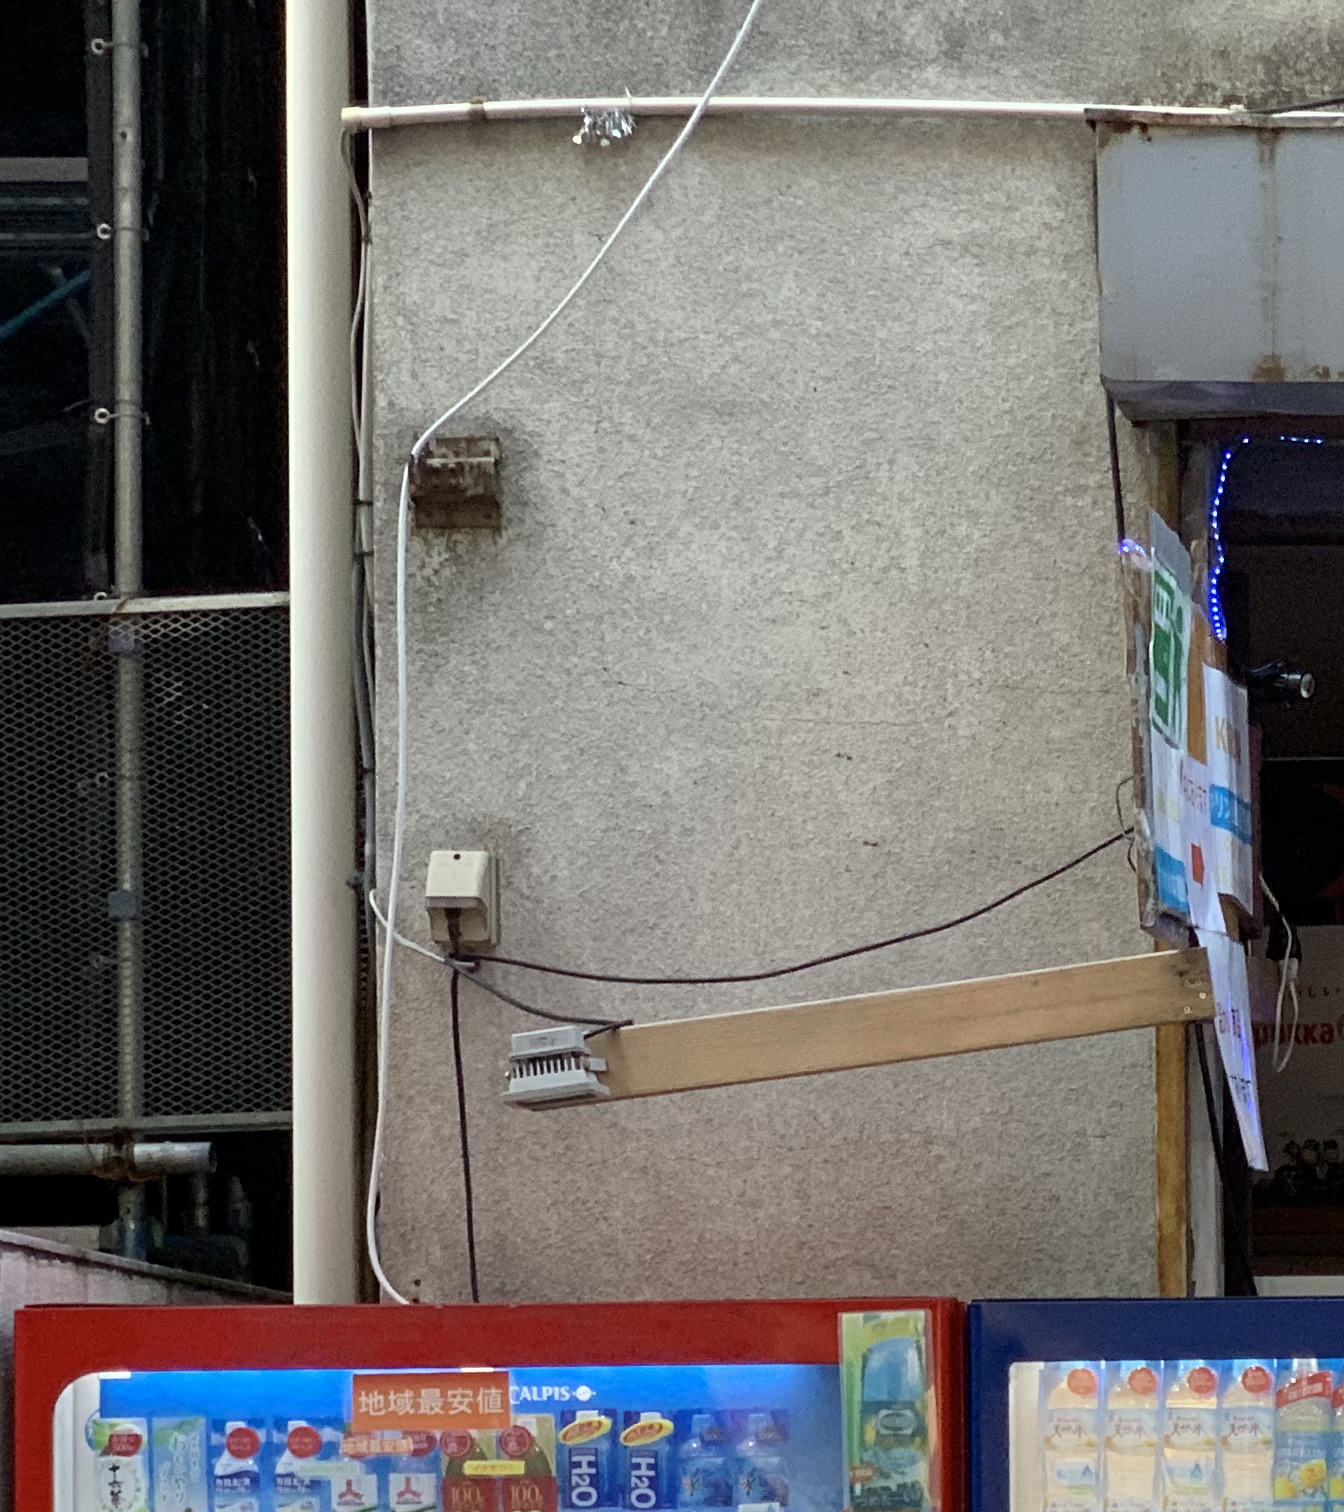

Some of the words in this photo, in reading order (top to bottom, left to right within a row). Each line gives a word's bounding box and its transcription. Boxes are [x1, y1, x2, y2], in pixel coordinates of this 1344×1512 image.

[358, 1386, 504, 1418] 地域最安値
[509, 1385, 571, 1402] CALPIS
